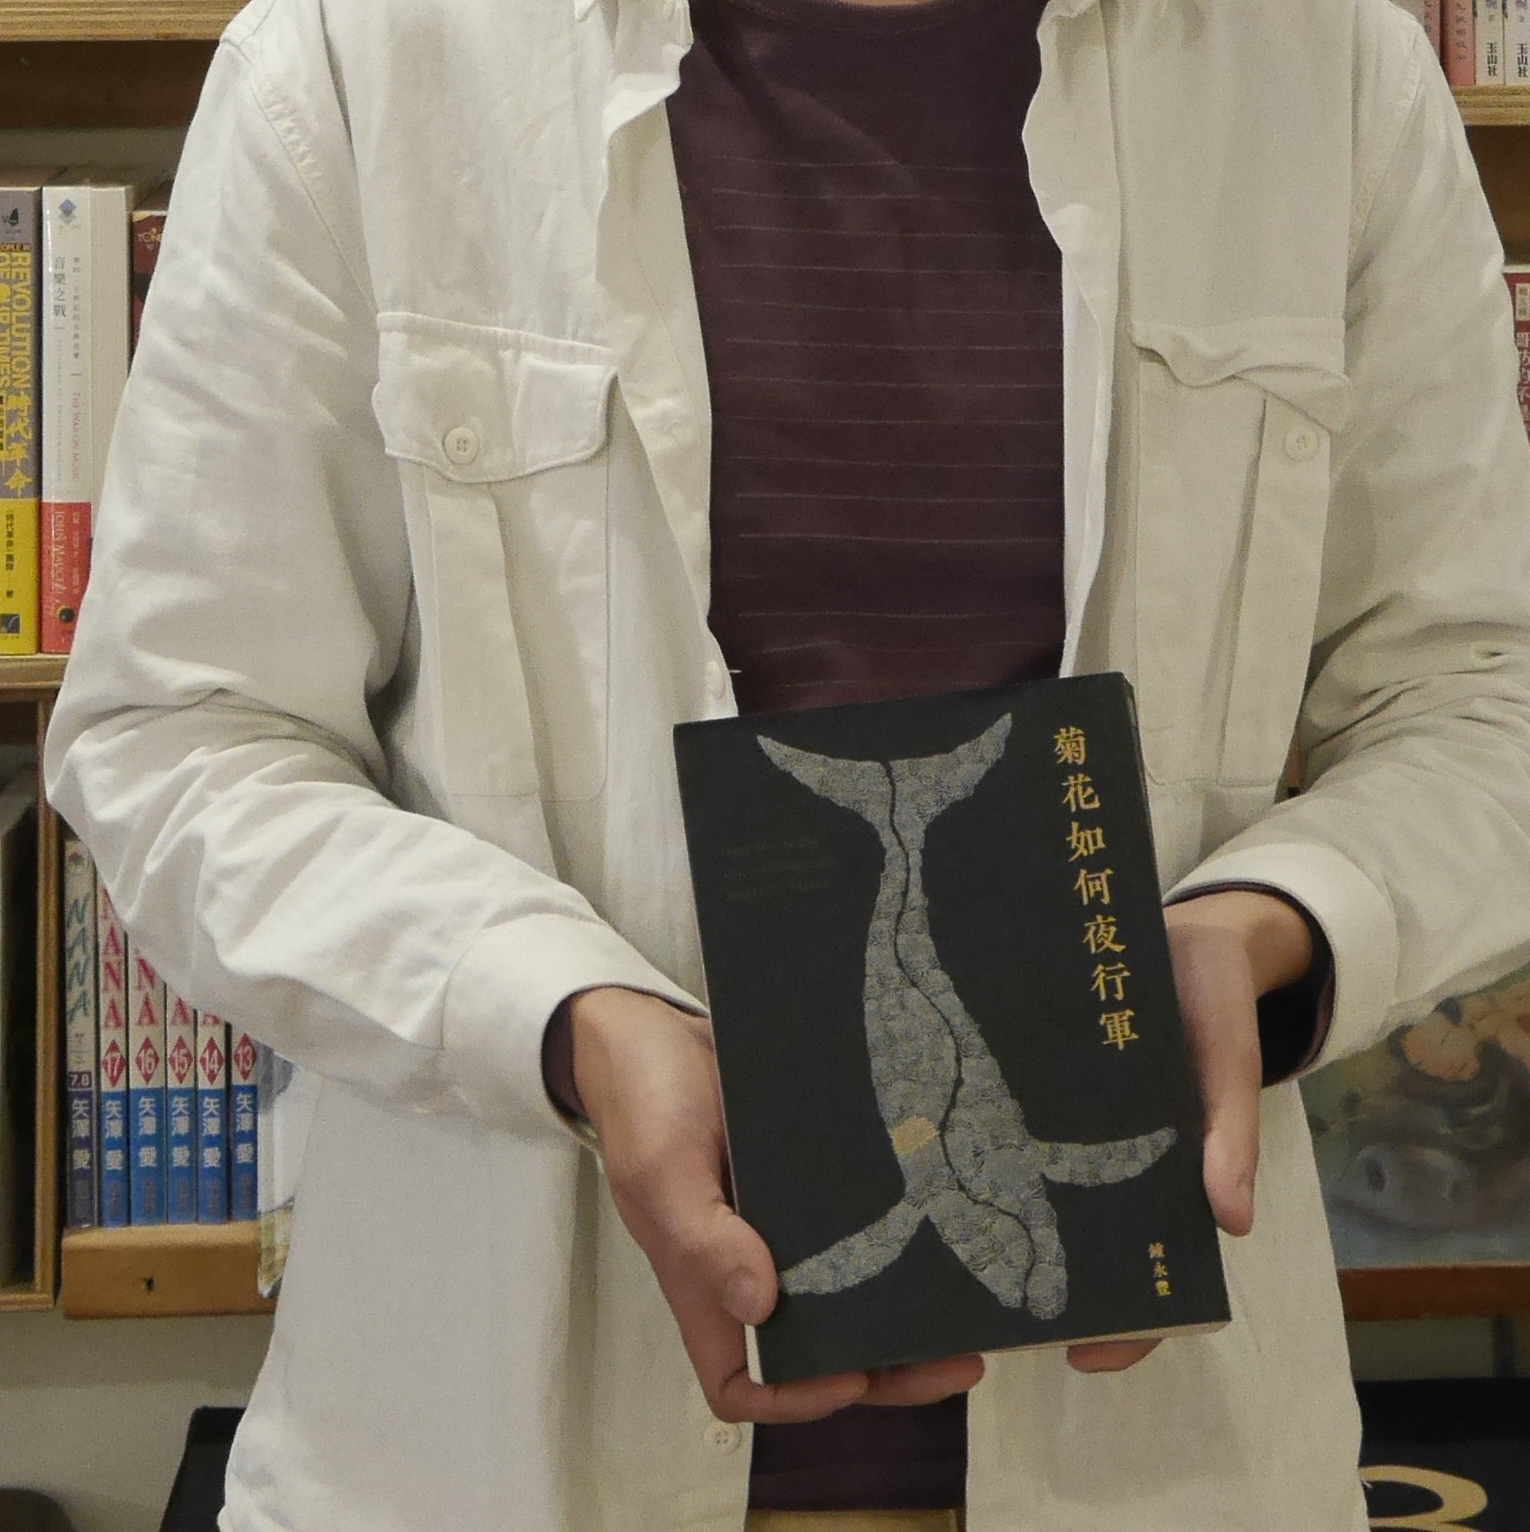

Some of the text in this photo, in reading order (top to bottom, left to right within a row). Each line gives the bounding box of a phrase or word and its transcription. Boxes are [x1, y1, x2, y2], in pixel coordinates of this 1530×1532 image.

[1486, 42, 1498, 77] 玉山社
[1517, 42, 1529, 78] 玉山社
[53, 256, 66, 317] 音樂之戰
[12, 252, 32, 389] REVOLUTION
[1053, 727, 1140, 1050] 菊花如何夜行軍
[69, 893, 92, 1023] NANA
[104, 1050, 125, 1078] 17
[137, 1049, 158, 1074] 16
[170, 1048, 191, 1074] 15
[201, 1049, 221, 1074] 14
[236, 1046, 255, 1070] 13
[72, 1098, 90, 1139] 矢澤
[104, 1100, 124, 1139] 矢澤
[137, 1096, 158, 1137] 矢澤
[171, 1096, 191, 1136] 矢澤
[202, 1097, 221, 1138] 矢澤
[236, 1093, 255, 1133] 矢澤
